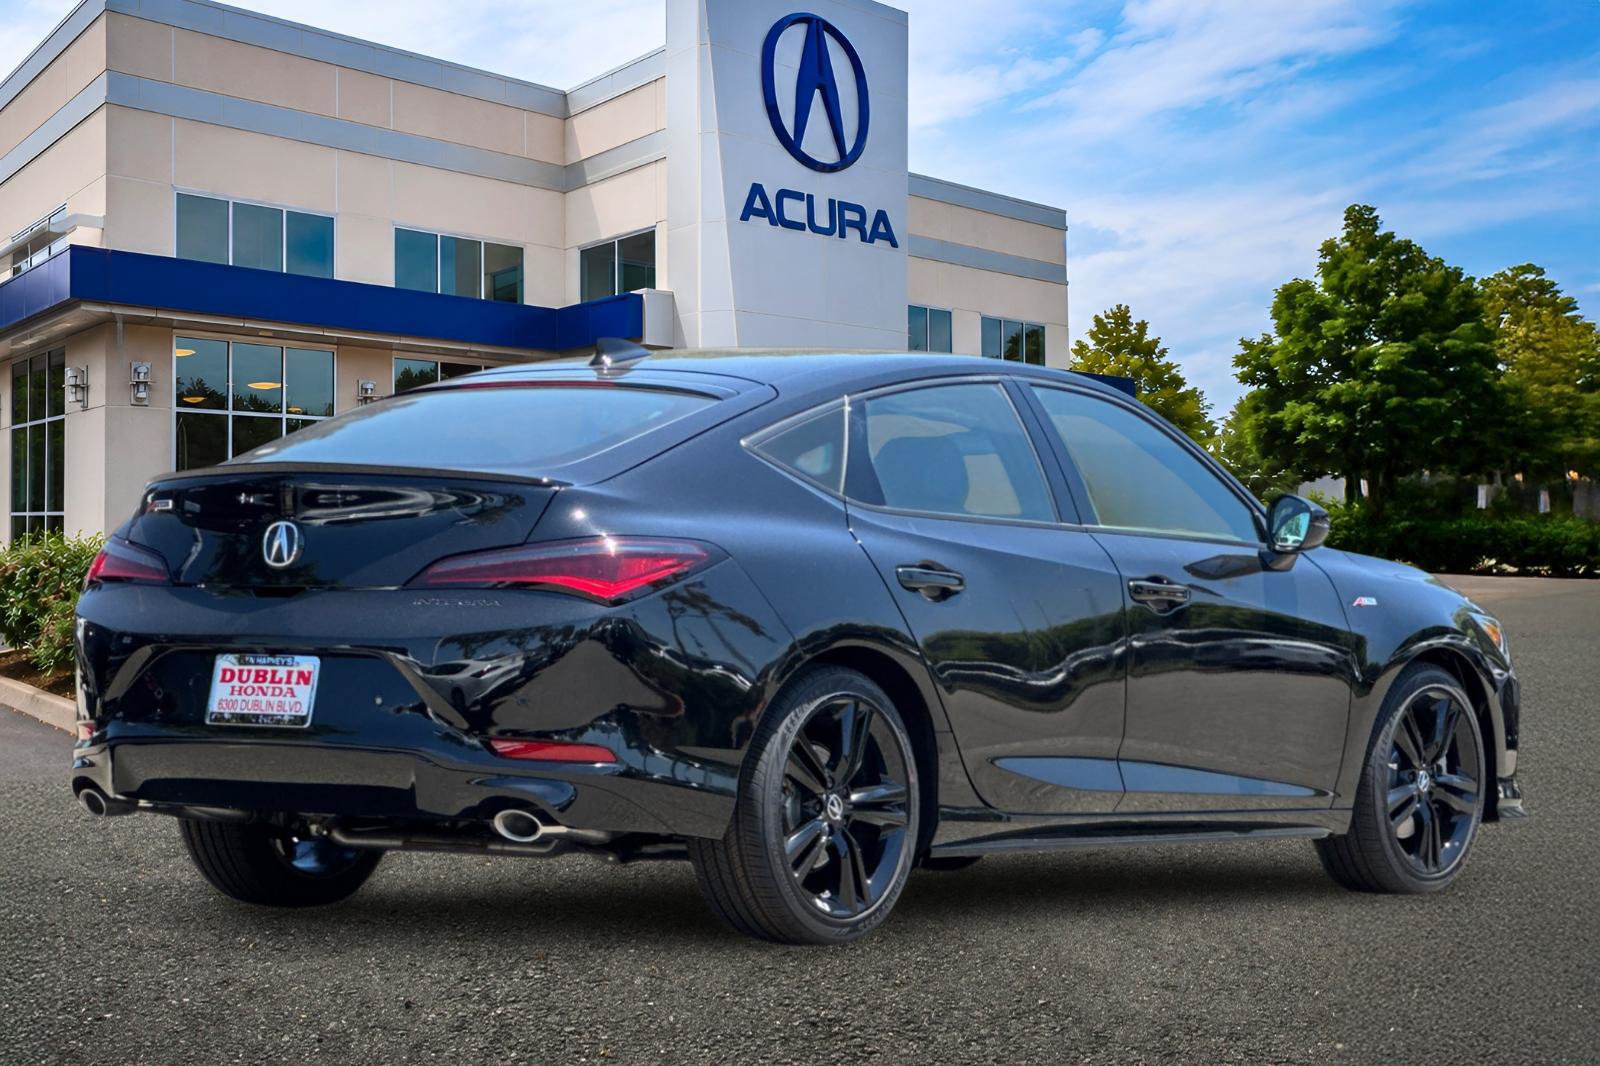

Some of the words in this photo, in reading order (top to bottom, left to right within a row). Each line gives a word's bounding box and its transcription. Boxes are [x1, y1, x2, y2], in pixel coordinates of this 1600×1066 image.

[739, 182, 899, 249] ACURA
[219, 667, 313, 686] DUBLIN
[229, 685, 297, 698] HONDA
[217, 698, 239, 712] 6300
[240, 699, 274, 713] DUBLIN
[275, 701, 304, 713] BLVD.
